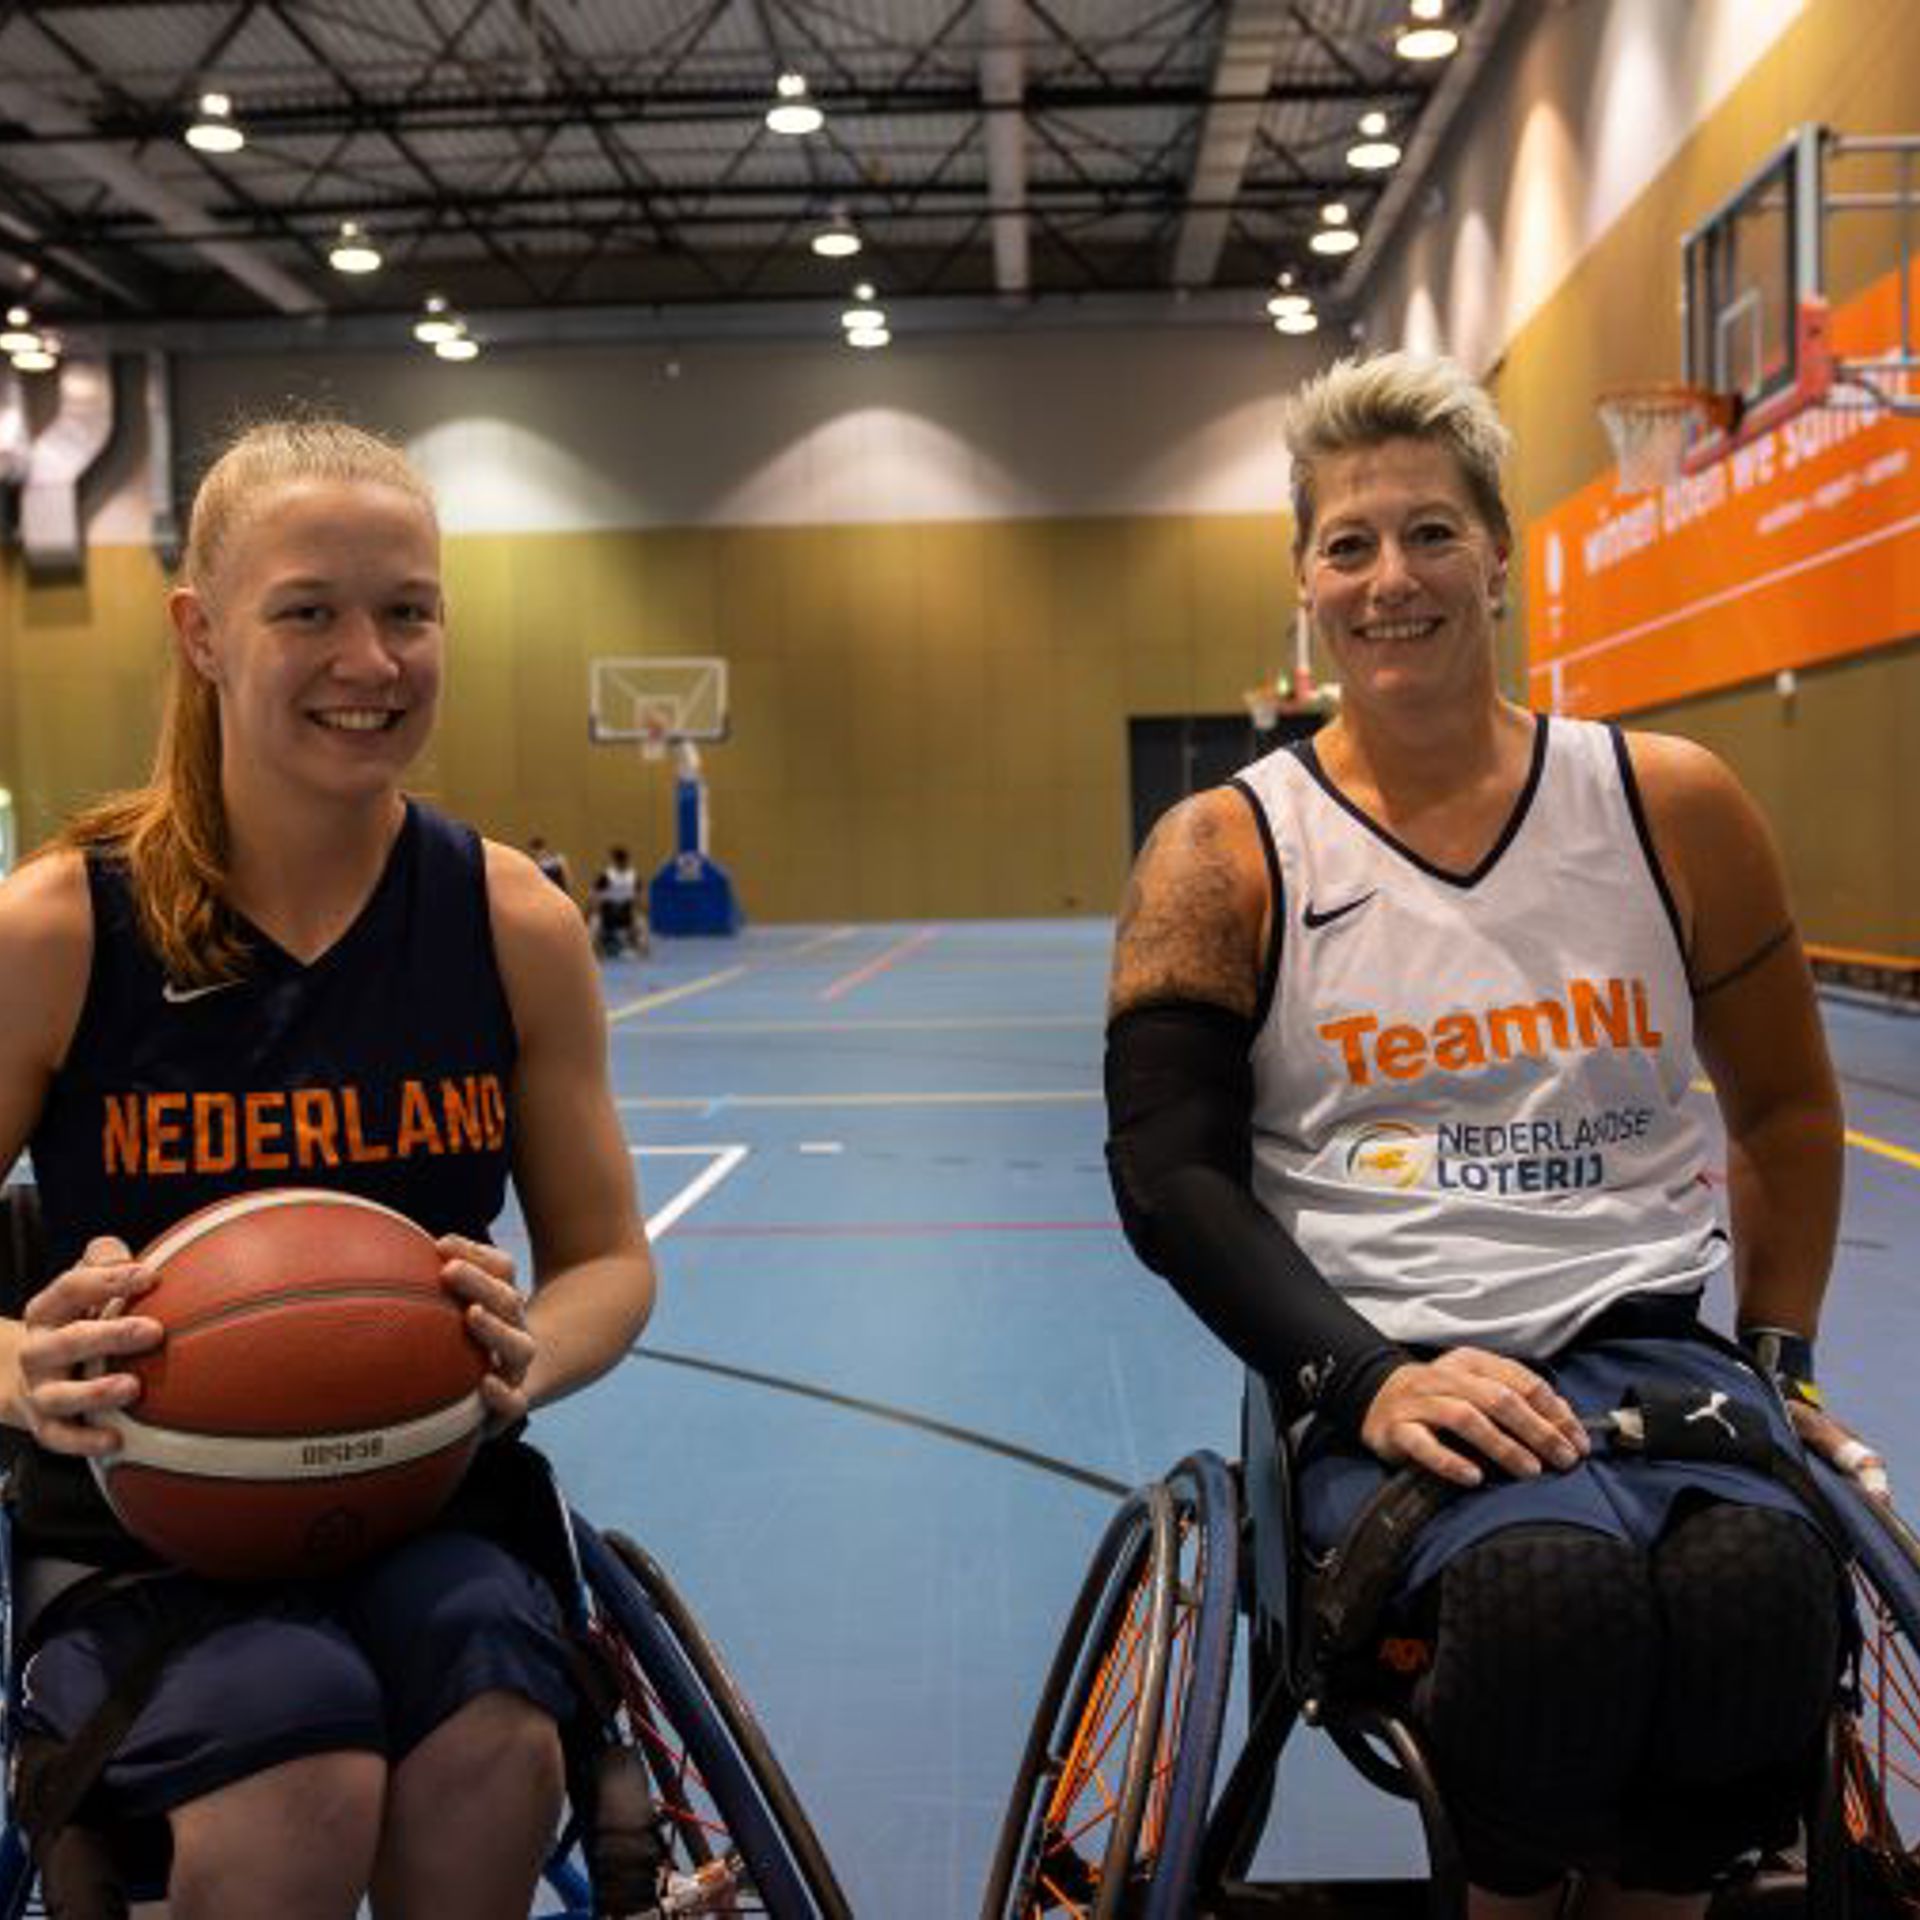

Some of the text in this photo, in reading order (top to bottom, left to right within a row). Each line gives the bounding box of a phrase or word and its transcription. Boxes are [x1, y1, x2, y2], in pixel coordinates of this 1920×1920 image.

[1318, 977, 1663, 1086] TeamNL
[104, 1073, 506, 1176] NEDERLAND
[1438, 1107, 1654, 1159] NEDERLANDSE
[1437, 1153, 1603, 1193] LOTERIJ
